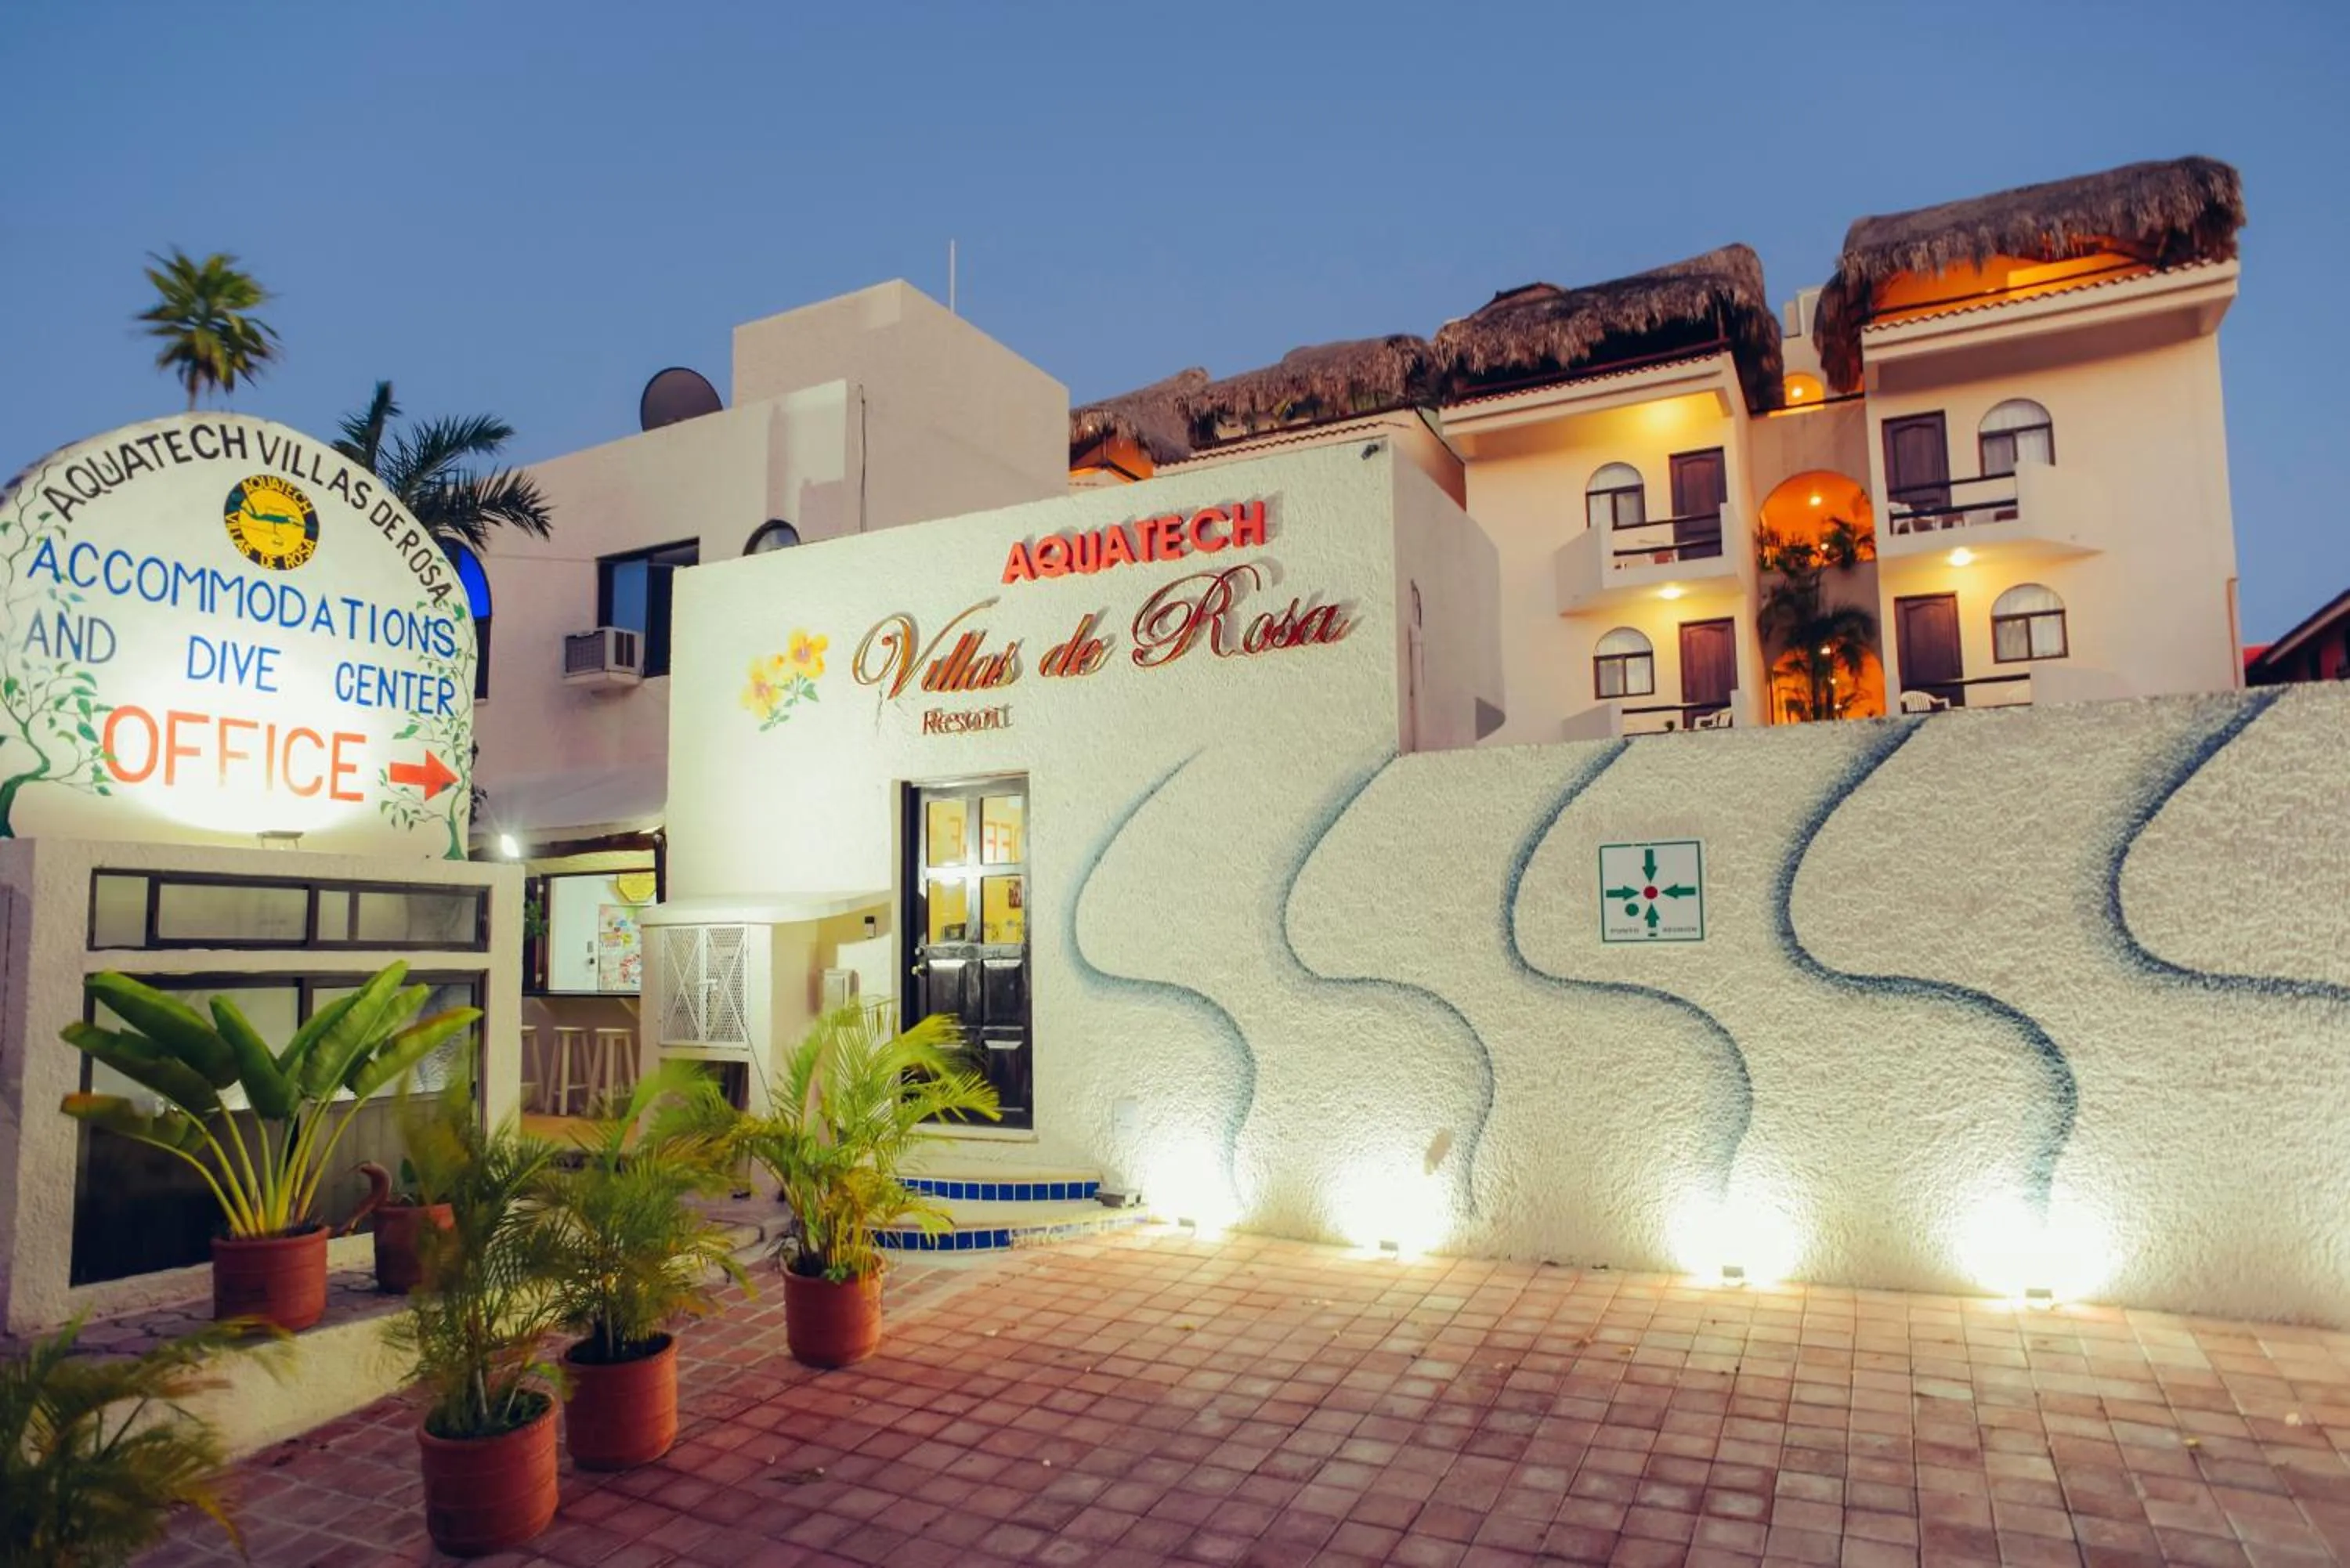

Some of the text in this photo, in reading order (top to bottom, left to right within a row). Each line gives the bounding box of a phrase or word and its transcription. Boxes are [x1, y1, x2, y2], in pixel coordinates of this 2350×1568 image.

[43, 424, 453, 606] AQUATECH VILLAS DE ROSA
[225, 511, 316, 570] VILLAS DE ROSA
[241, 475, 314, 514] AQUATECH
[1001, 500, 1267, 585] AQUATECH
[27, 536, 456, 659] ACCOMMODATIONS
[852, 564, 1349, 700] Villas de Rosa
[22, 609, 456, 716] AND DIVE CENTER
[103, 705, 367, 802] OFFICE
